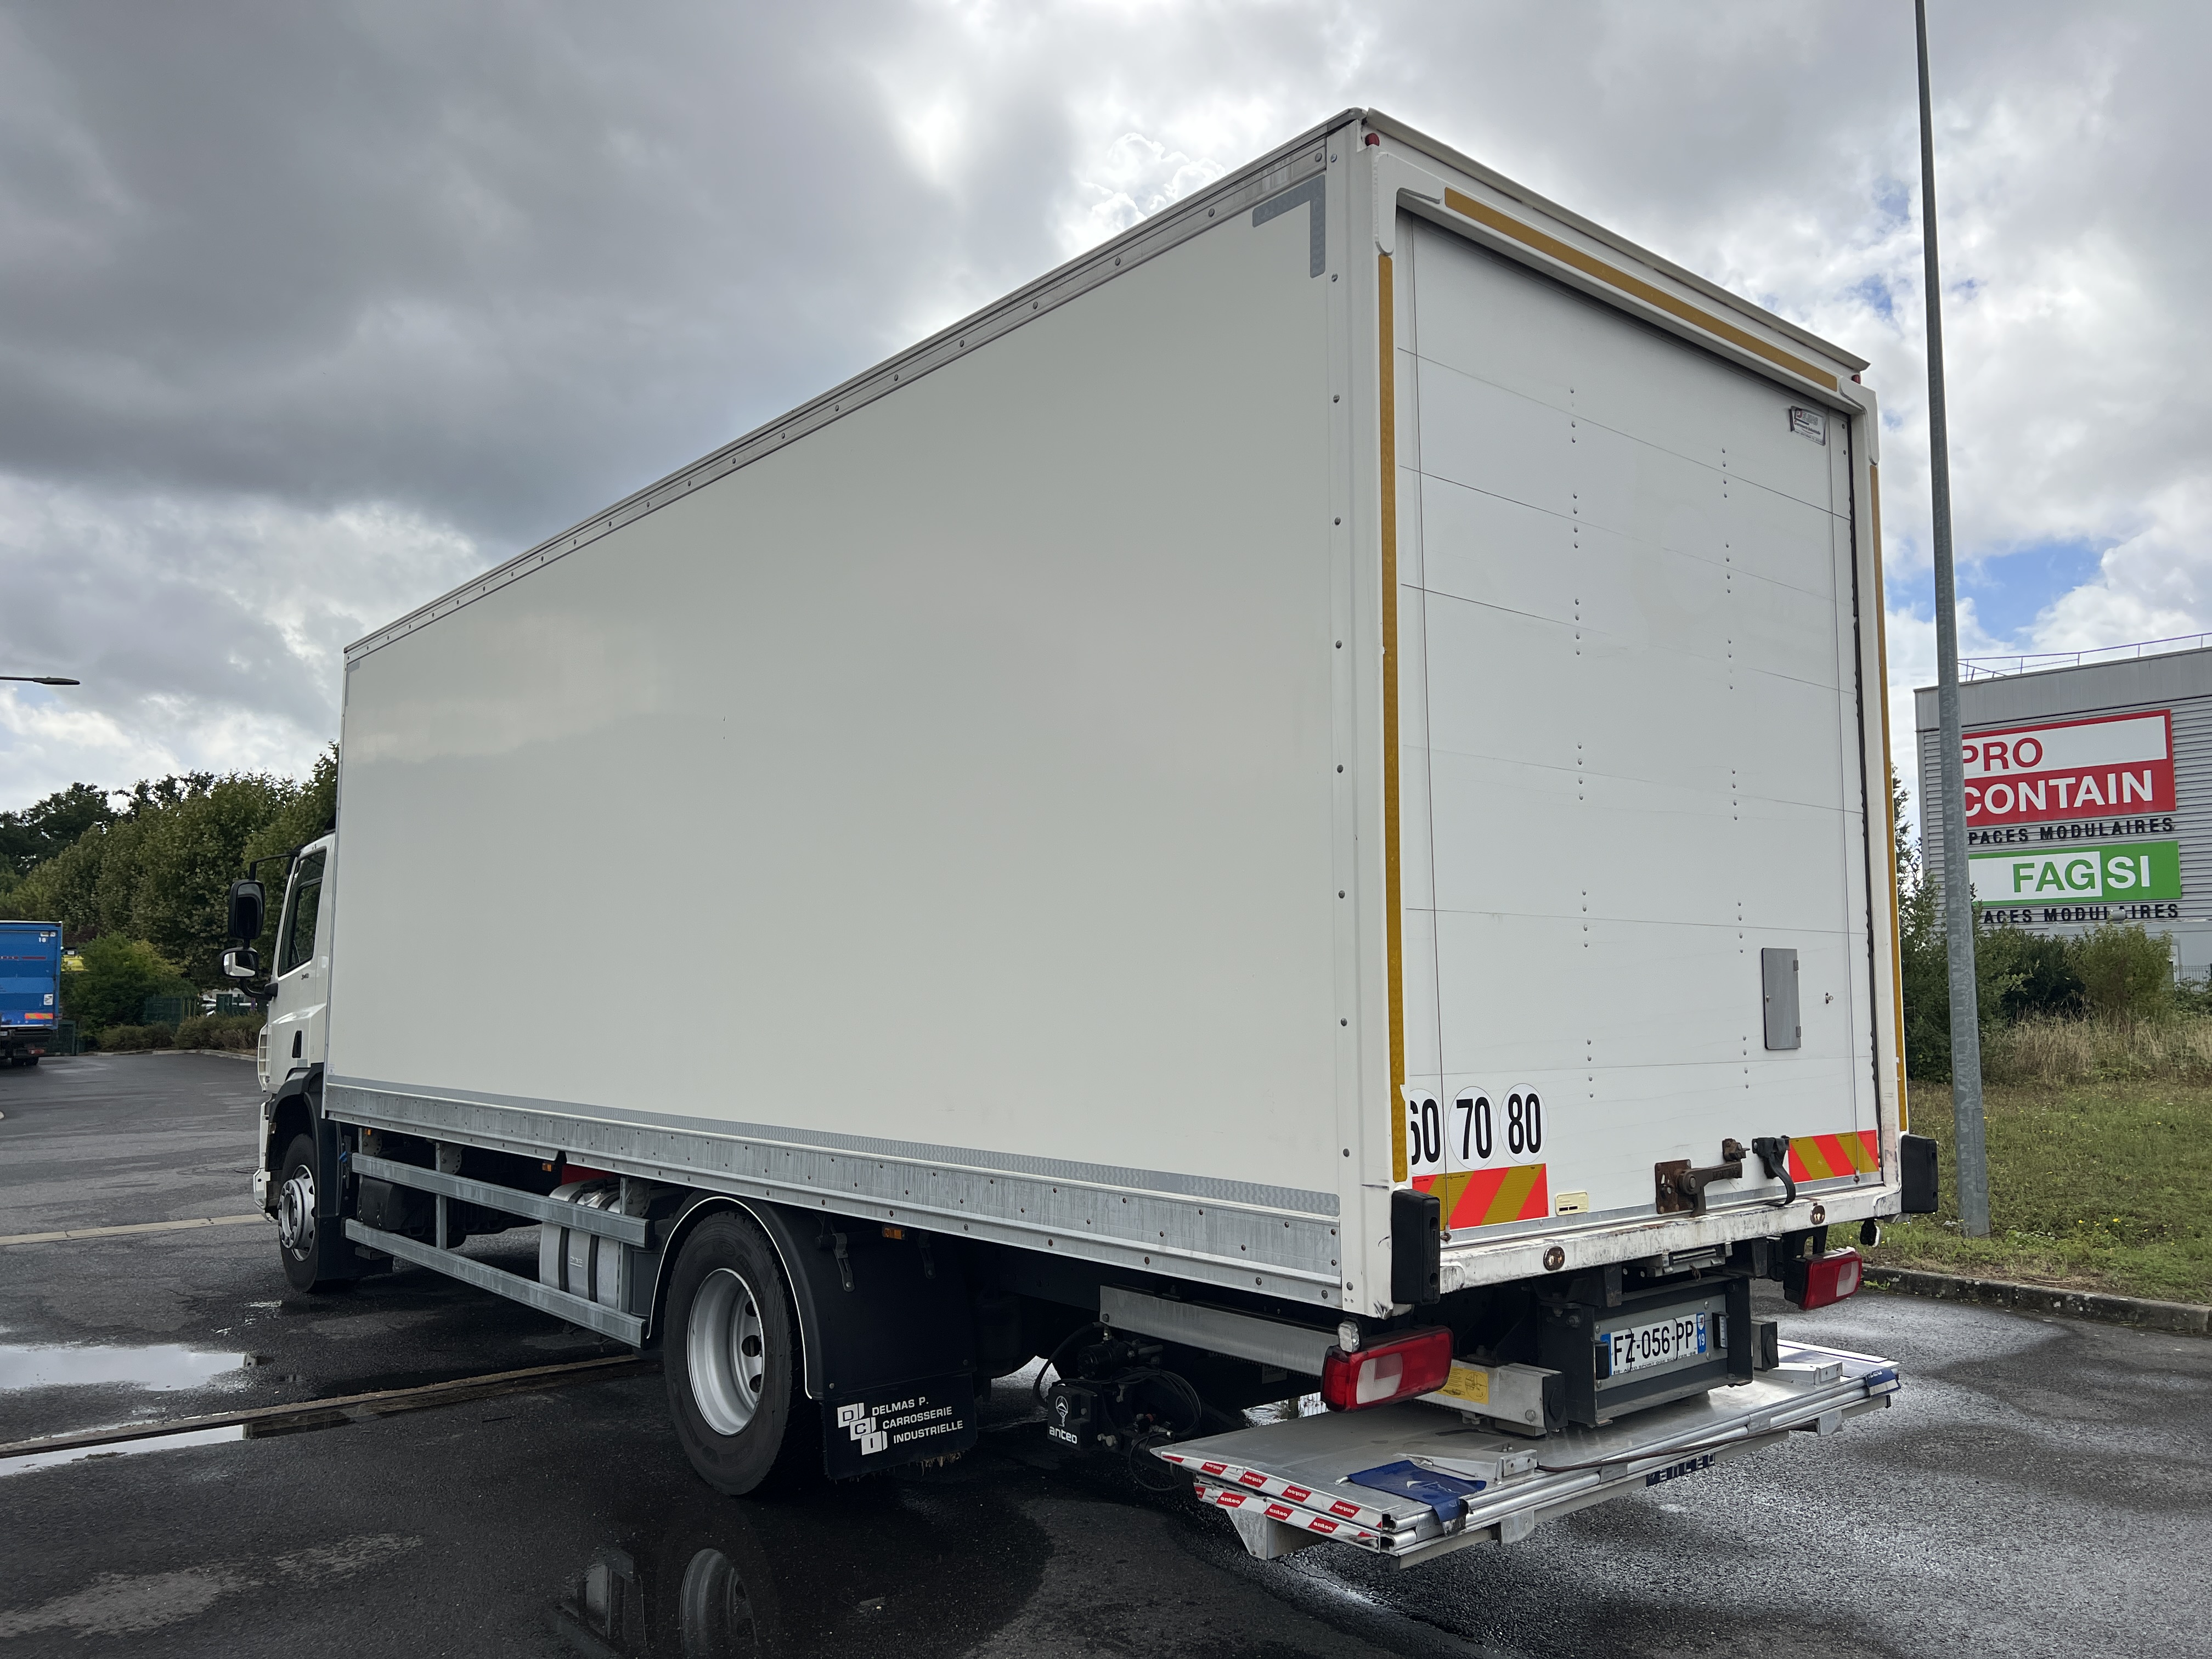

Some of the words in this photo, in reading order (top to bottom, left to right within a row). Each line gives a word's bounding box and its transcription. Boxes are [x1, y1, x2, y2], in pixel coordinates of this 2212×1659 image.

[1962, 737, 2043, 771] PRO
[1965, 770, 2153, 817] CONTAIN
[1968, 828, 2029, 845] PACES
[2040, 817, 2174, 840] MODULAIRES
[2012, 855, 2151, 893] FAGSI
[1984, 909, 2032, 924] ACES
[2044, 904, 2179, 922] MODULIRES
[1456, 1097, 1492, 1160] 70
[1508, 1093, 1542, 1154] 80
[1614, 1321, 1694, 1366] FZ-056-PP
[1698, 1333, 1706, 1346] 19
[872, 1399, 915, 1417] DELMAS
[919, 1396, 929, 1406] P.
[882, 1406, 952, 1429] CARROSSERIE
[893, 1420, 964, 1444] INDUSTRIELLE
[1049, 1426, 1077, 1444] anteo
[1220, 1496, 1241, 1504] anteo
[1287, 1488, 1307, 1498] anteo
[1269, 1508, 1288, 1517] anteo
[1335, 1504, 1355, 1514] anteo
[1313, 1521, 1333, 1531] anteo
